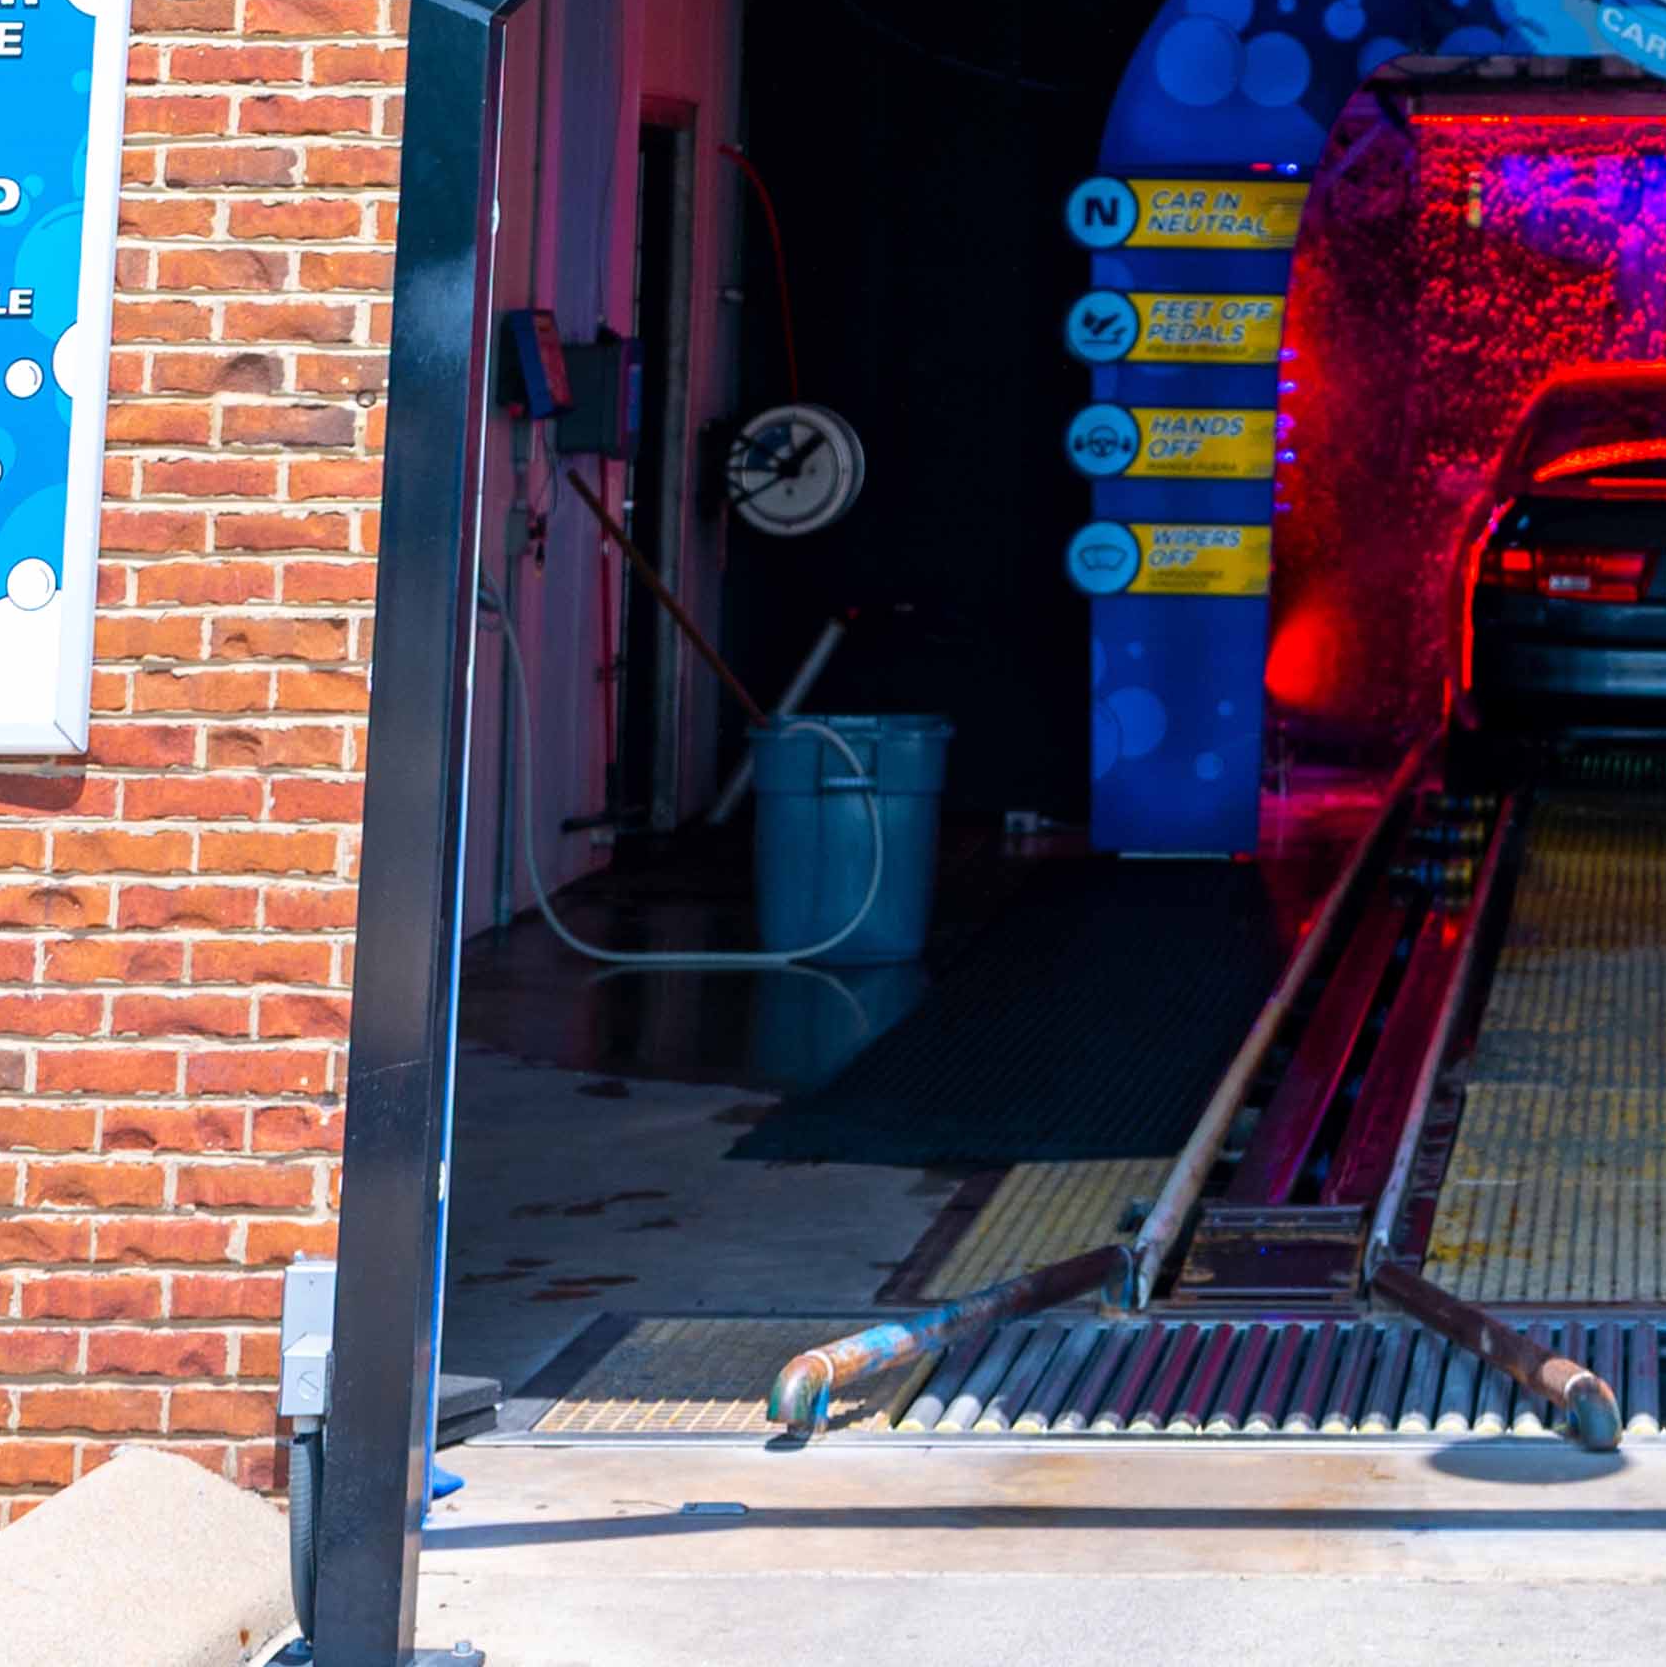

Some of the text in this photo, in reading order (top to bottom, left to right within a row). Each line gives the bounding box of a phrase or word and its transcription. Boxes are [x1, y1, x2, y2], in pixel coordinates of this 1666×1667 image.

[1151, 189, 1242, 211] CAR IN
[1084, 197, 1118, 227] N
[1147, 213, 1269, 237] NEUTRAL
[1150, 299, 1274, 321] FEET OFF
[1147, 322, 1246, 344] PEDALS
[1150, 414, 1245, 436] HANDS
[1147, 438, 1203, 459] OFF
[1152, 528, 1242, 548] WIPERS
[1147, 549, 1198, 567] OFF
